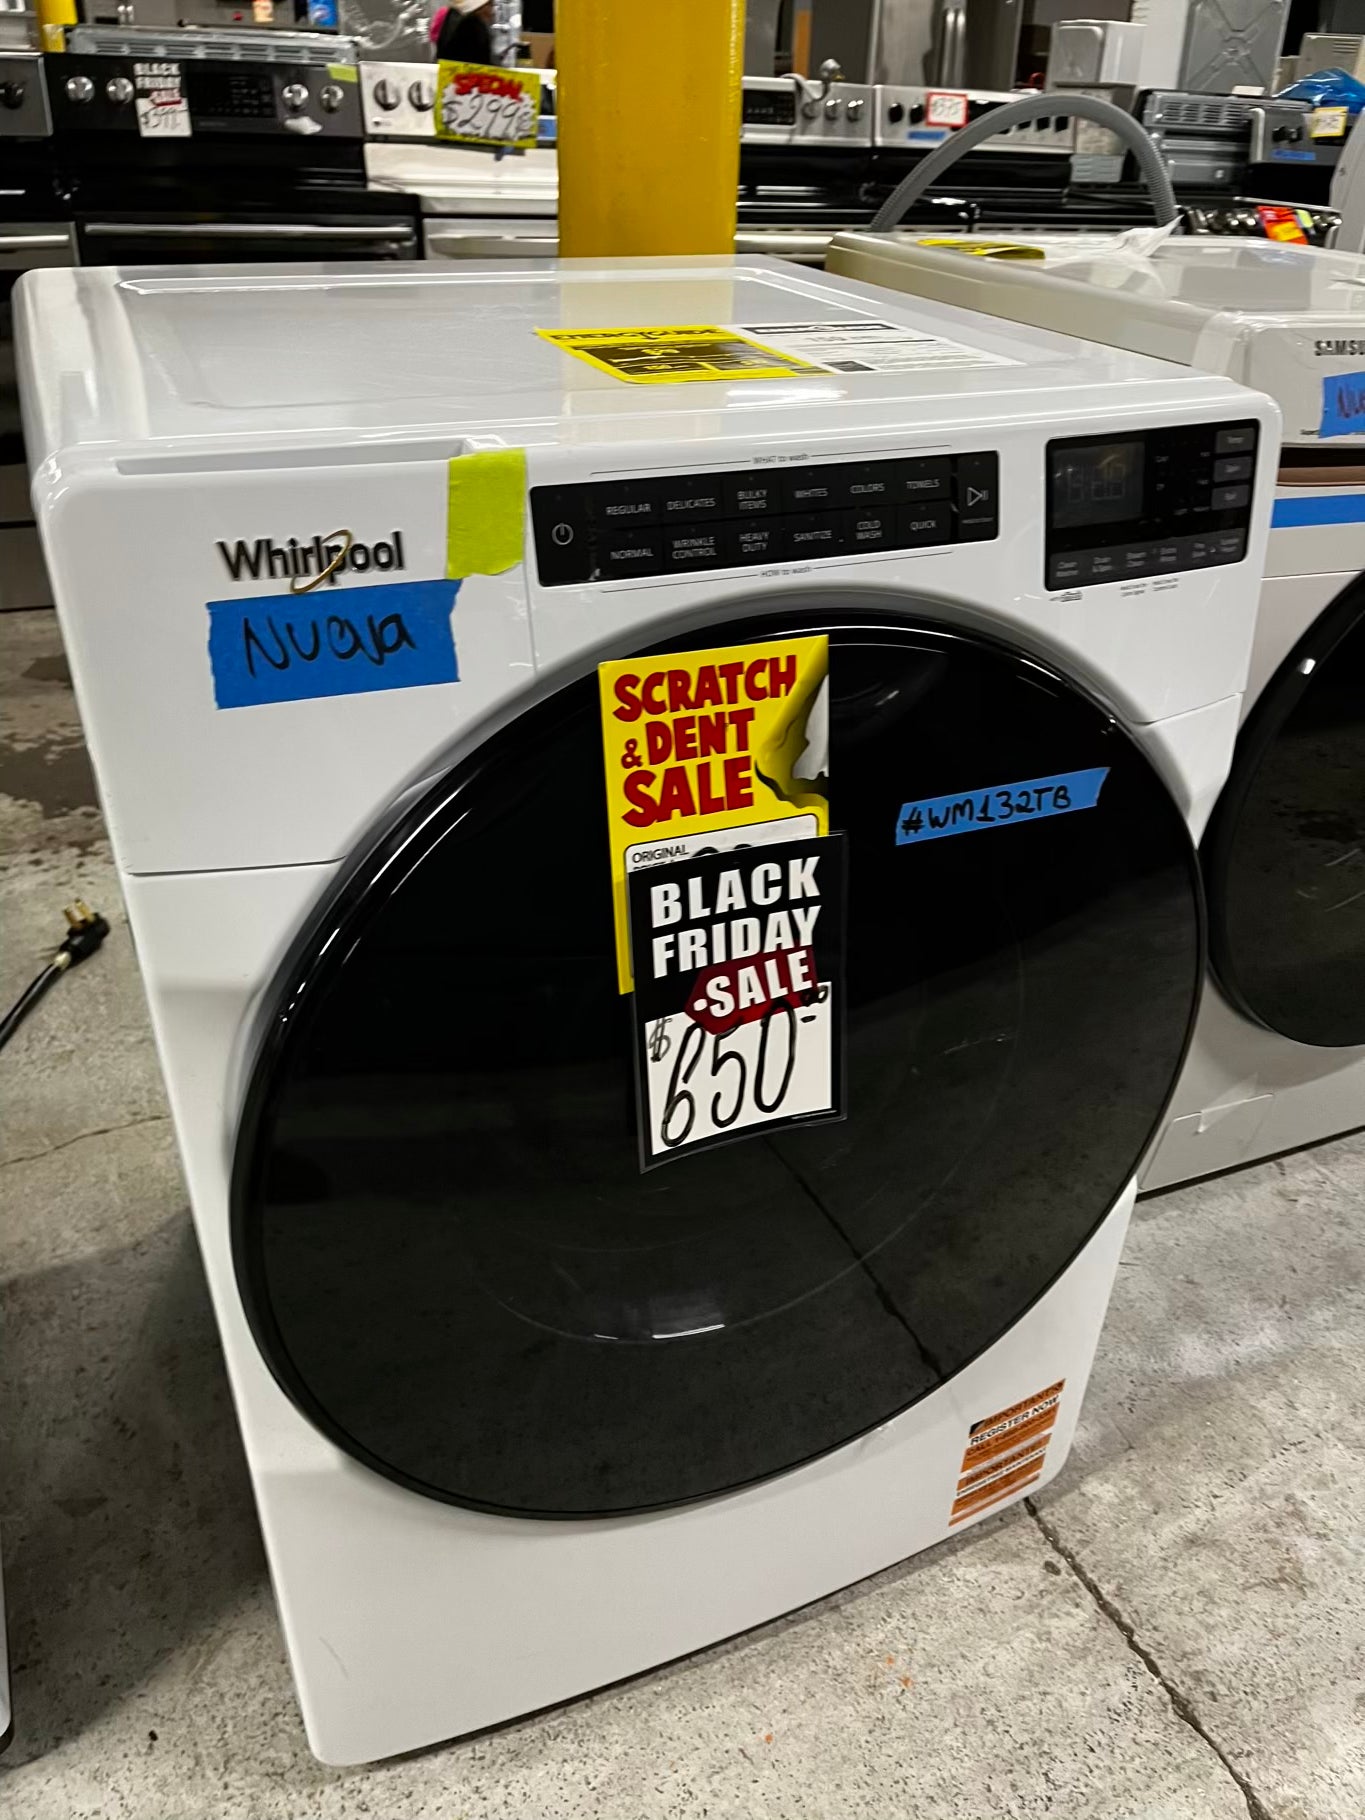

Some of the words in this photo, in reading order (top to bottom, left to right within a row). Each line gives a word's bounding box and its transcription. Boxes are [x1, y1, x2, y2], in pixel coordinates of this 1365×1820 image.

[850, 482, 885, 494] COLORS
[906, 478, 940, 489] TOWELS
[737, 489, 768, 500] BULKY
[794, 488, 829, 499] WHITES
[606, 503, 652, 516] REGULAR
[666, 498, 716, 511] DELICATES
[738, 500, 767, 510] ITEMS
[856, 519, 882, 530] COLD
[909, 519, 938, 532] QUICK
[739, 531, 770, 542] HEAVY
[793, 530, 833, 542] SANITIZE
[856, 530, 882, 540] WASH
[672, 536, 716, 548] WRINKLE
[741, 542, 768, 553] DUTY
[216, 530, 405, 585] Whirlpool
[610, 548, 654, 560] NORMAL
[672, 547, 718, 560] CONTROL
[613, 655, 797, 723] SCRATCH
[621, 738, 643, 770] &
[645, 707, 755, 766] DENT
[621, 755, 754, 828] SALE
[901, 785, 1072, 836] #WM132TB
[632, 844, 689, 863] ORIGINAL
[651, 856, 822, 929] BLACK
[652, 905, 822, 979] FRIDAY
[706, 949, 813, 1018] SALE
[970, 1411, 1030, 1446] REGISTER
[1031, 1394, 1060, 1416] NOW
